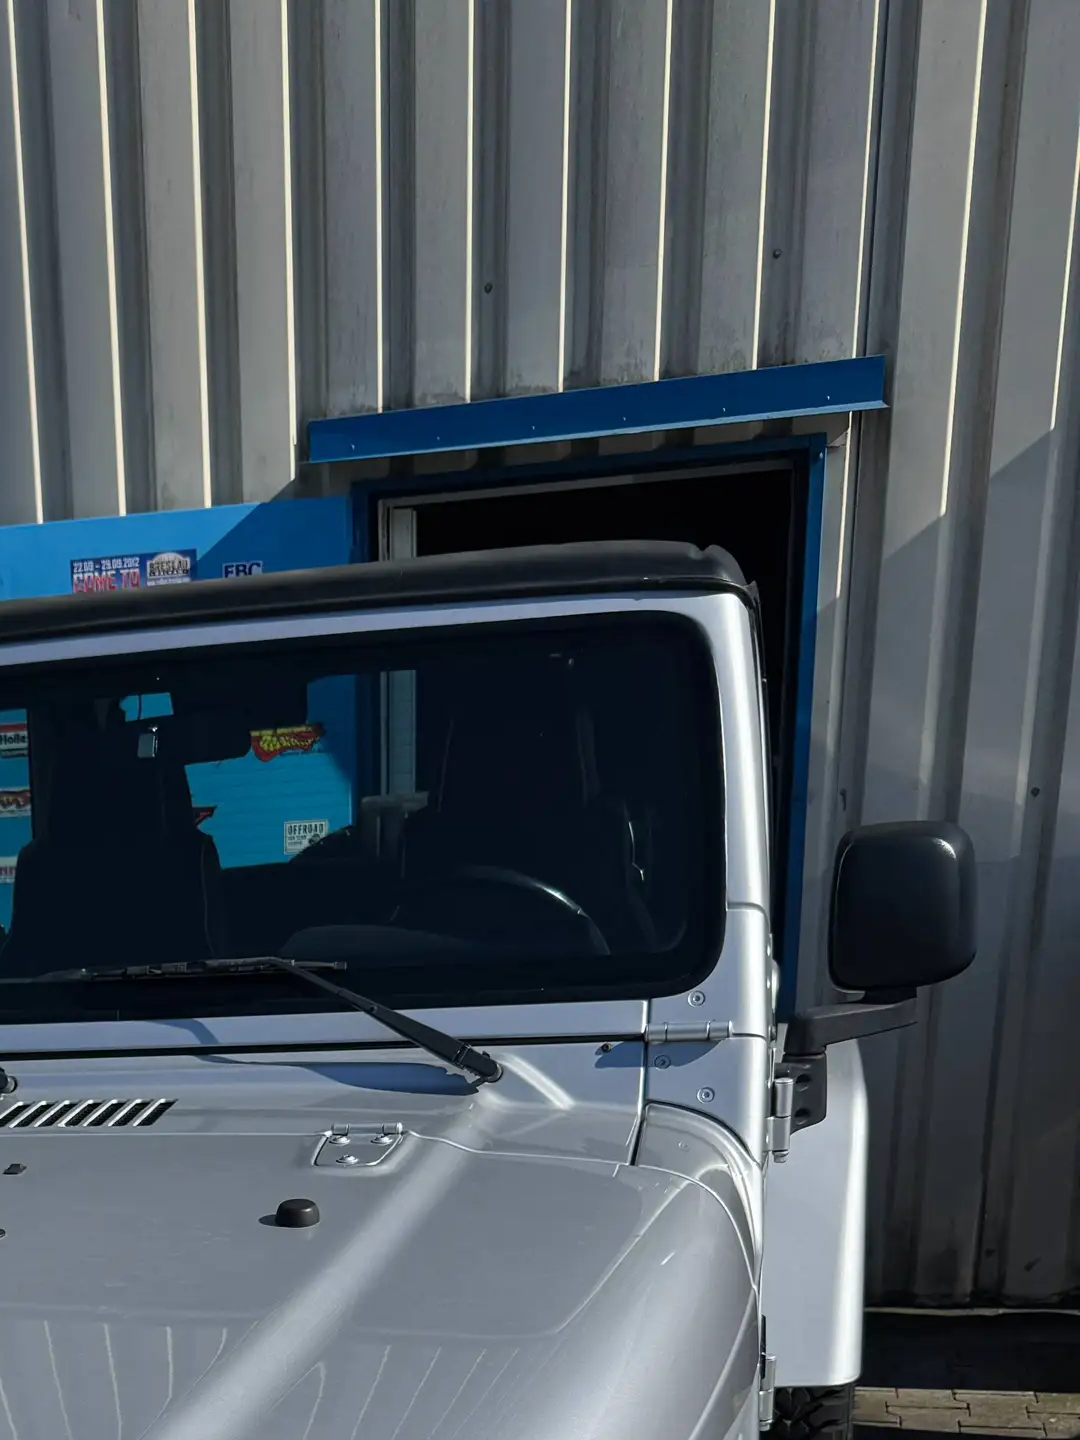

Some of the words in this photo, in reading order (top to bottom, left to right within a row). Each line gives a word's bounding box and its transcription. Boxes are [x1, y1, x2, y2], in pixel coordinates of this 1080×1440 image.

[72, 569, 117, 593] COME
[120, 567, 141, 590] TO
[287, 823, 324, 836] OFFROAD
